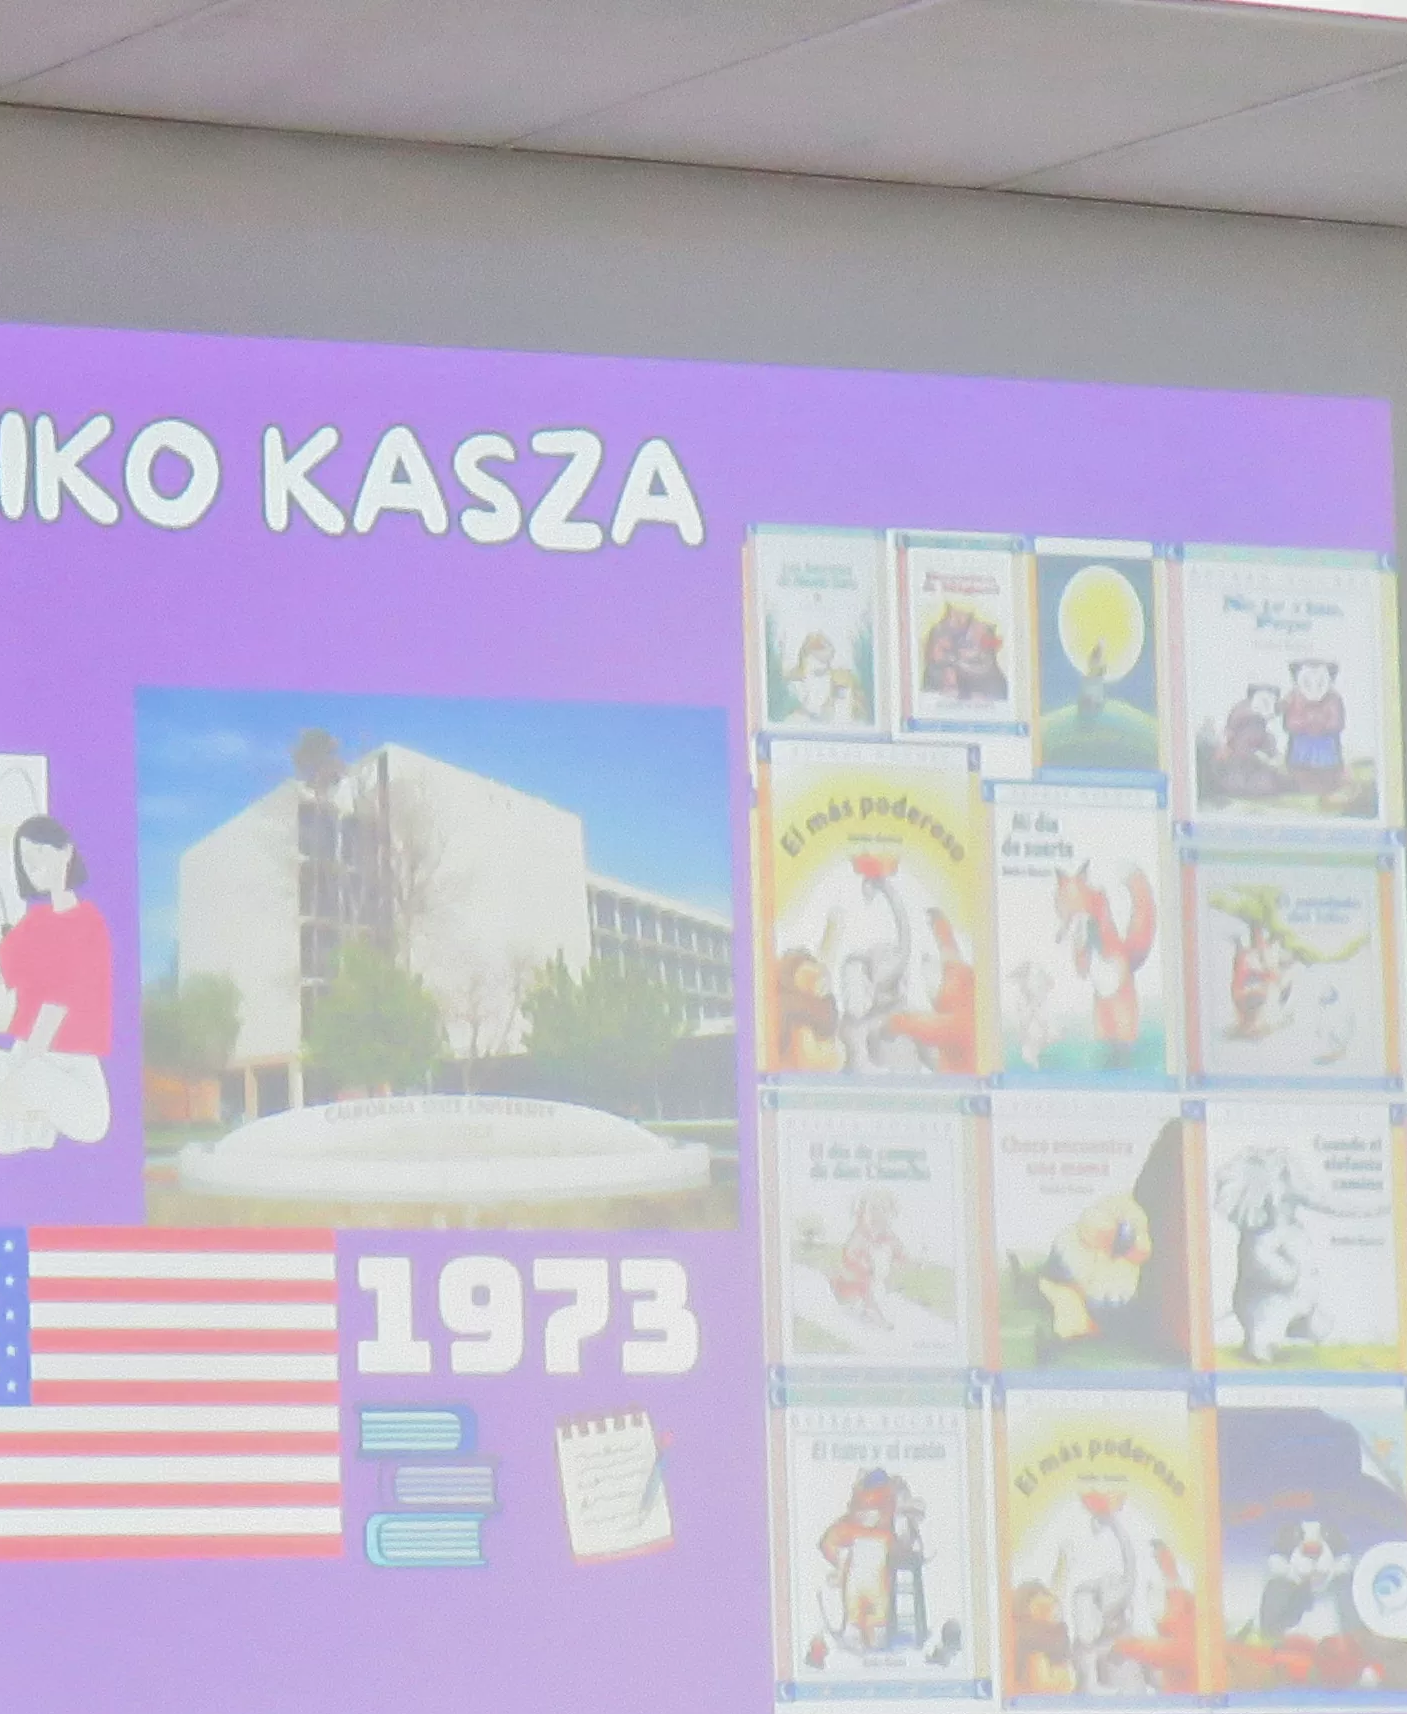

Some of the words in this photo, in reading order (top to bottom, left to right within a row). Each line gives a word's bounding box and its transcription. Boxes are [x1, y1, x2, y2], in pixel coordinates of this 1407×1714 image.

[262, 423, 706, 553] KASZA
[780, 823, 806, 857] El
[806, 797, 854, 836] más
[859, 795, 966, 861] poderoso
[357, 1255, 700, 1375] 1973
[1087, 1437, 1186, 1499] poderoso
